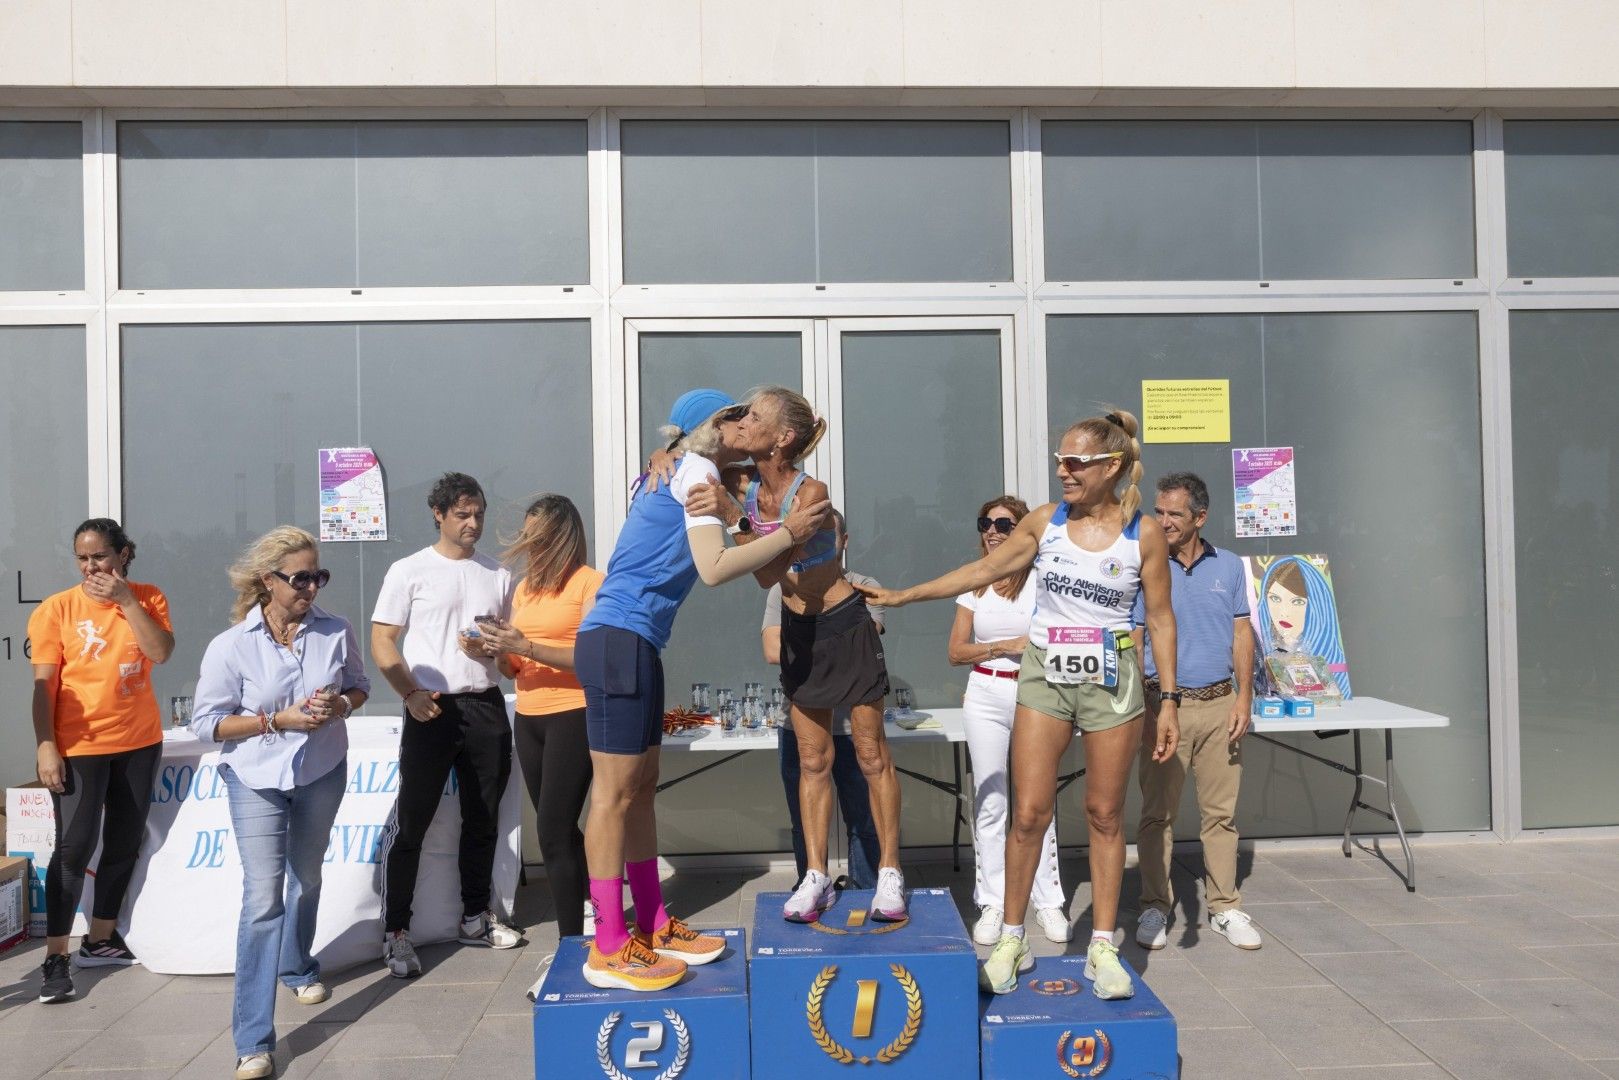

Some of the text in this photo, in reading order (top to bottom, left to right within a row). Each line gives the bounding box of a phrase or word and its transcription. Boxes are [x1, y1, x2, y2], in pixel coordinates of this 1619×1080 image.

[1043, 578, 1120, 608] Torrevieja
[1046, 571, 1124, 598] Club Atletismo
[1049, 655, 1099, 674] 150
[1105, 649, 1116, 669] KM
[186, 828, 230, 869] DE
[850, 979, 878, 1038] 1
[624, 1021, 664, 1068] 2
[1071, 1036, 1096, 1066] 3
